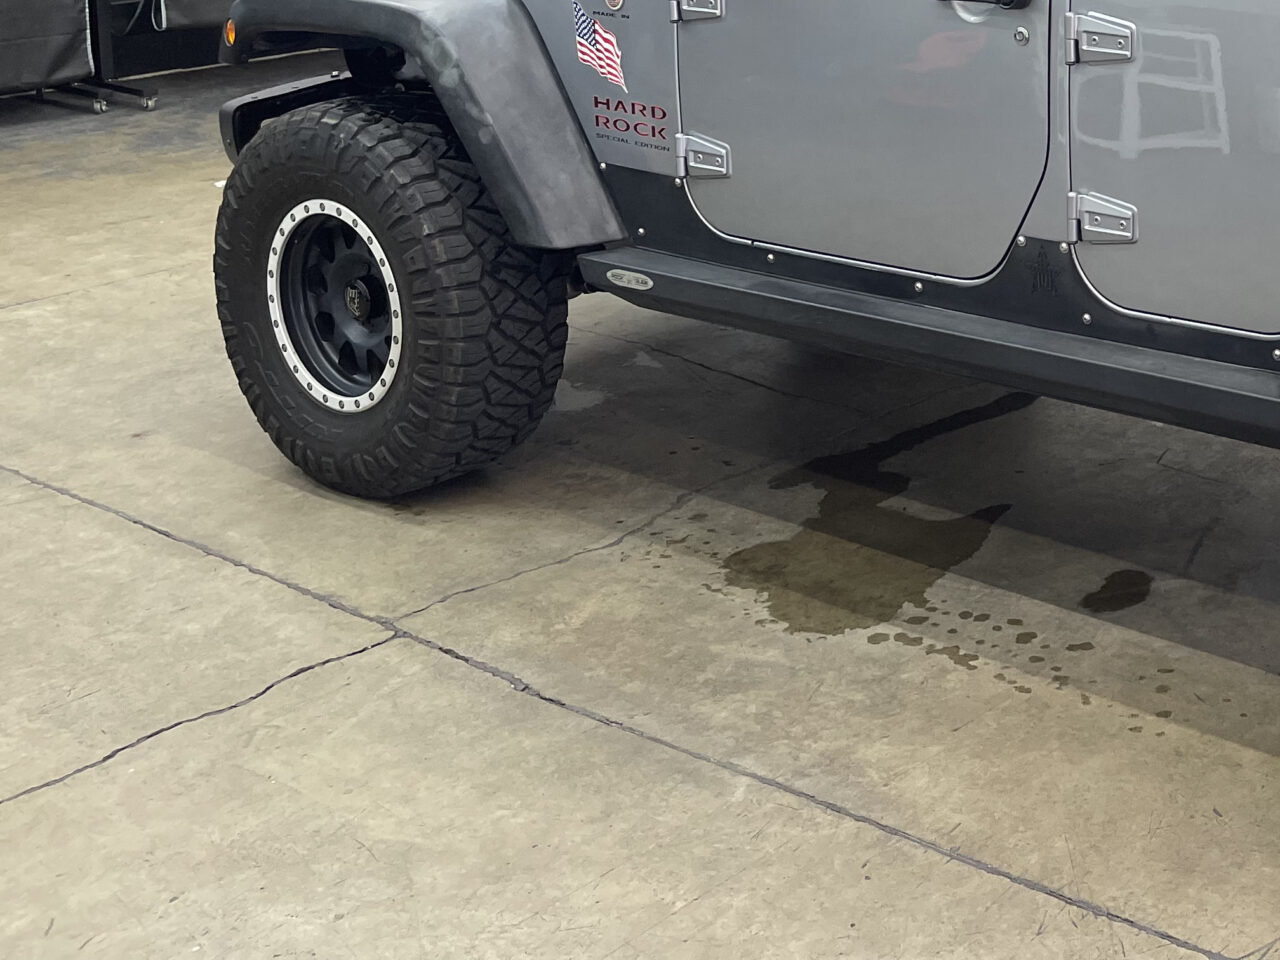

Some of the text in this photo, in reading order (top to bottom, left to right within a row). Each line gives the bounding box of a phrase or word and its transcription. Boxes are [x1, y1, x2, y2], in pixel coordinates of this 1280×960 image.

[593, 96, 667, 120] HARD
[594, 114, 667, 141] ROCK
[596, 132, 670, 152] SPECIAL EDITION
